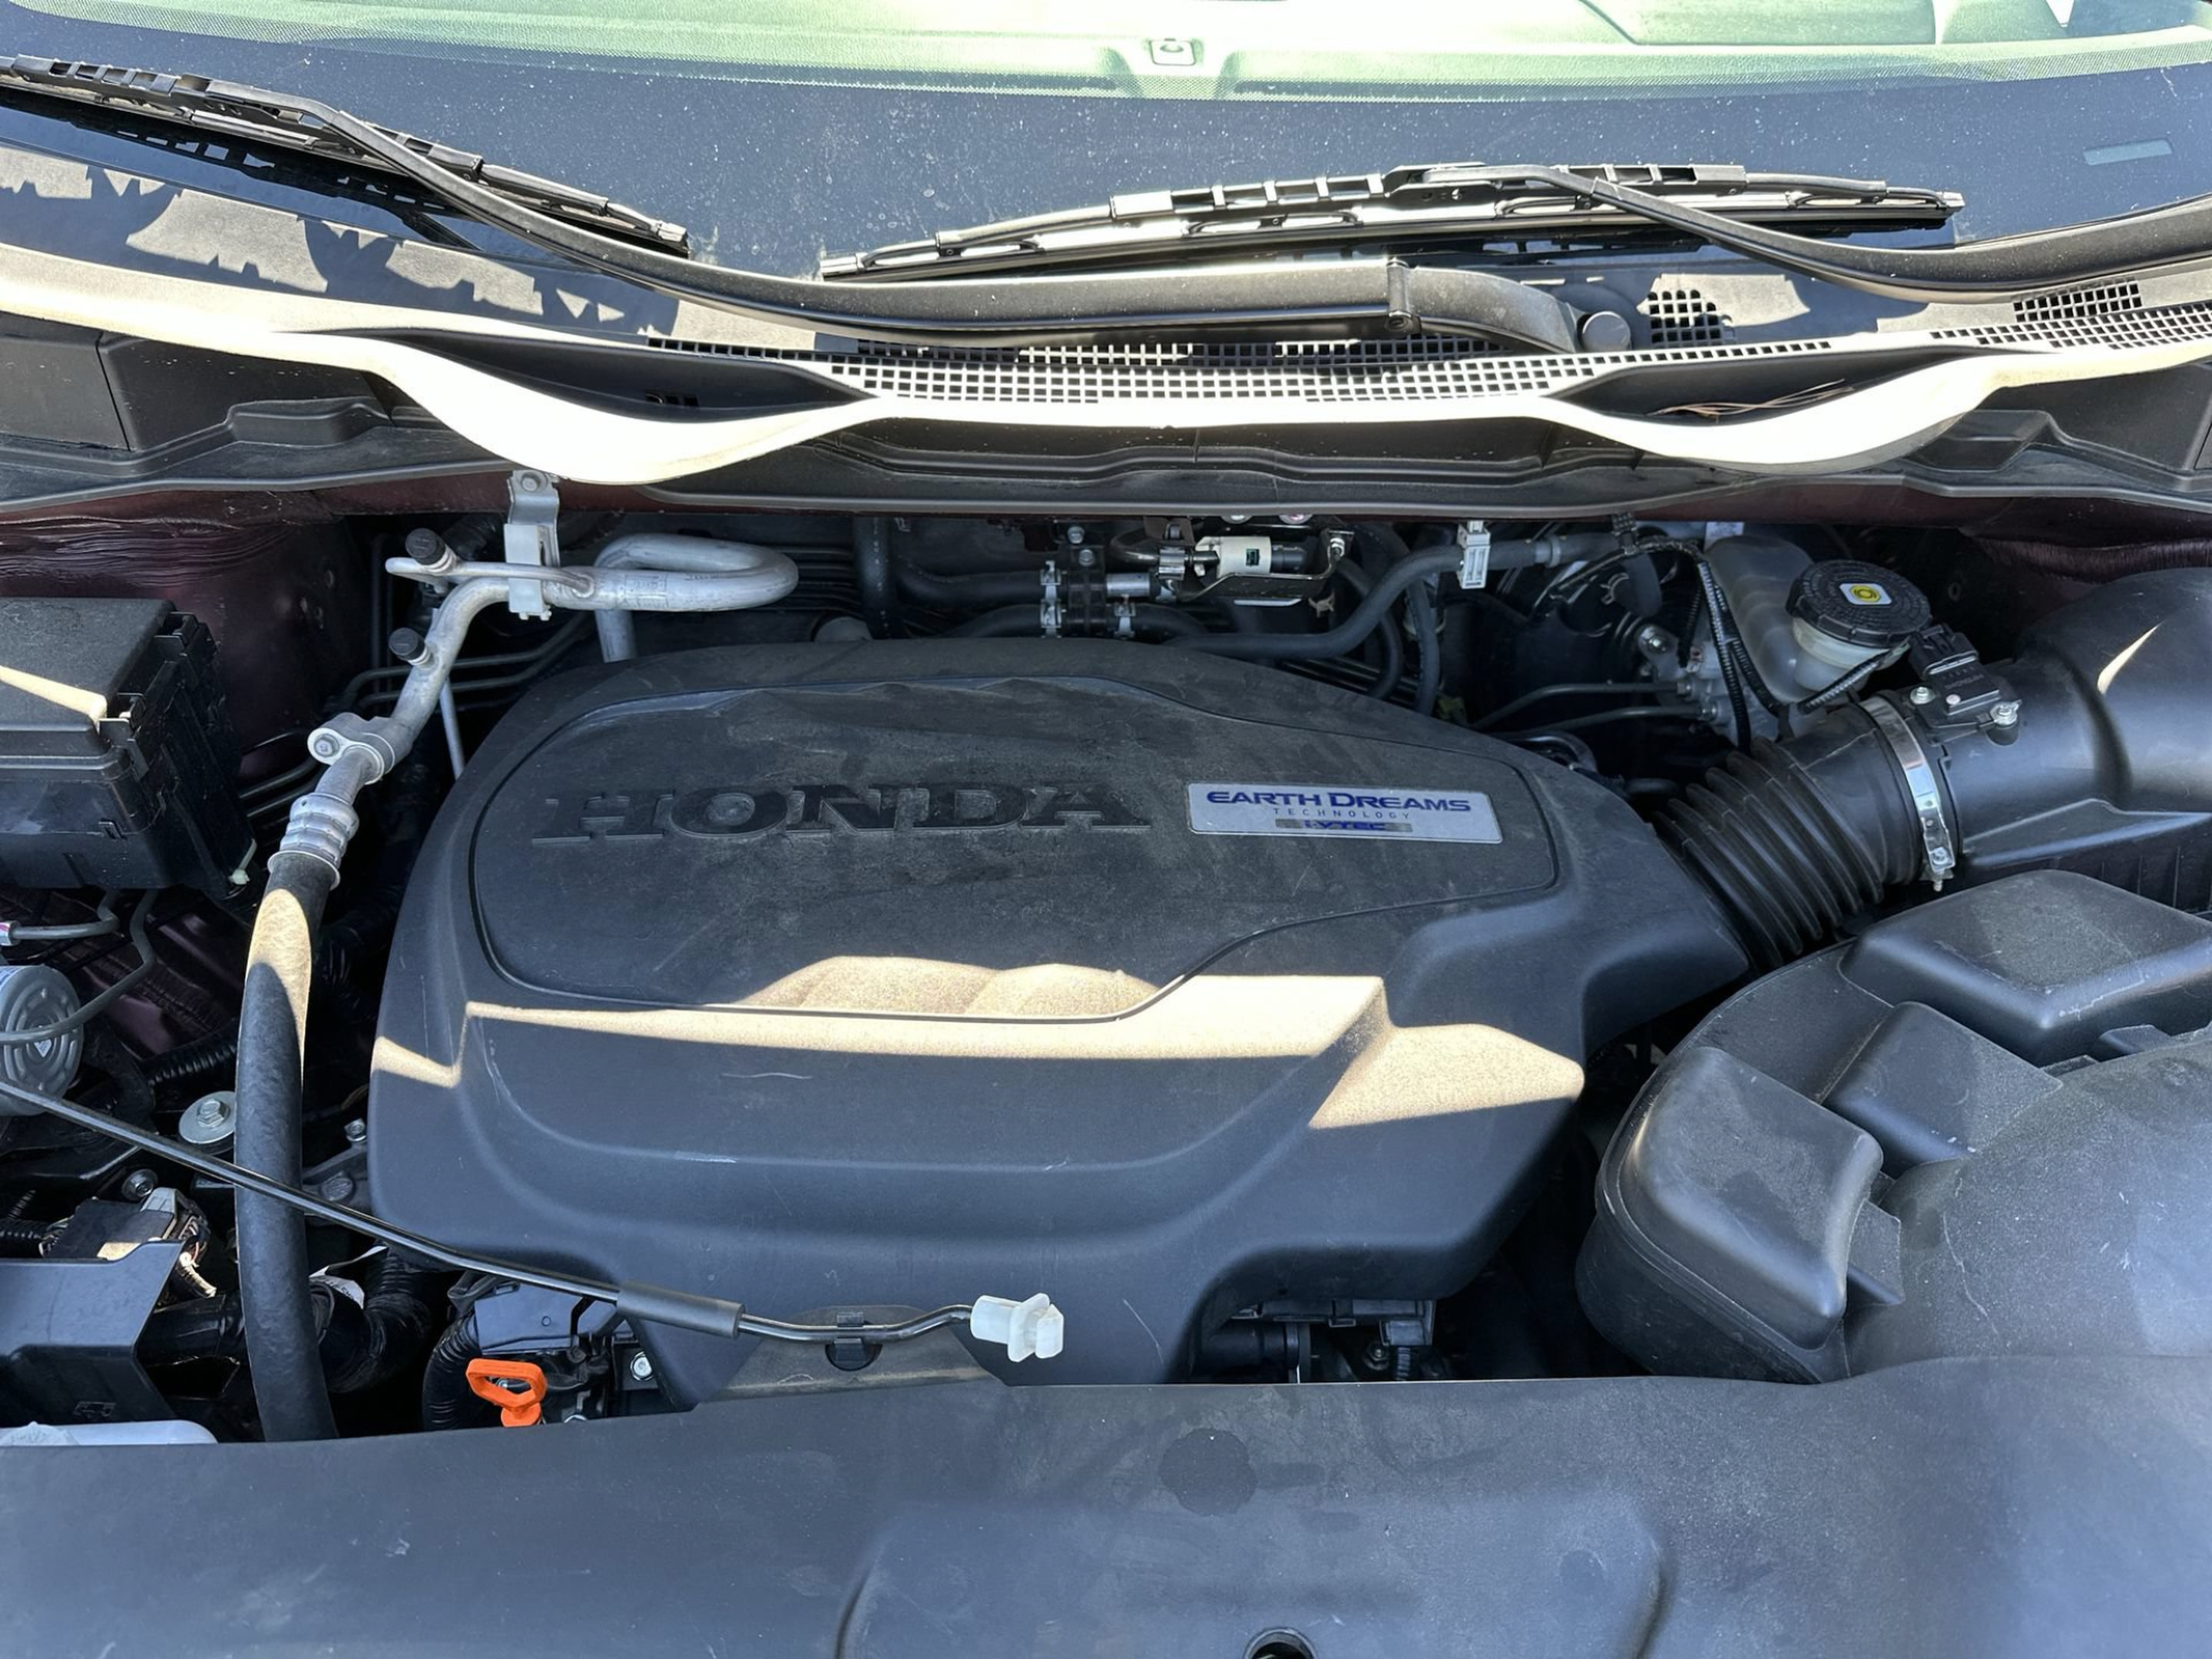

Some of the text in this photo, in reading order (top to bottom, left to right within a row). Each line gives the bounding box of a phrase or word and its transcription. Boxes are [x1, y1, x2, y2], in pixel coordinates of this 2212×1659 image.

[1207, 791, 1471, 812] EARTH DREAMS
[531, 784, 1151, 843] HONDA
[1273, 807, 1410, 820] TECHNOLOGY
